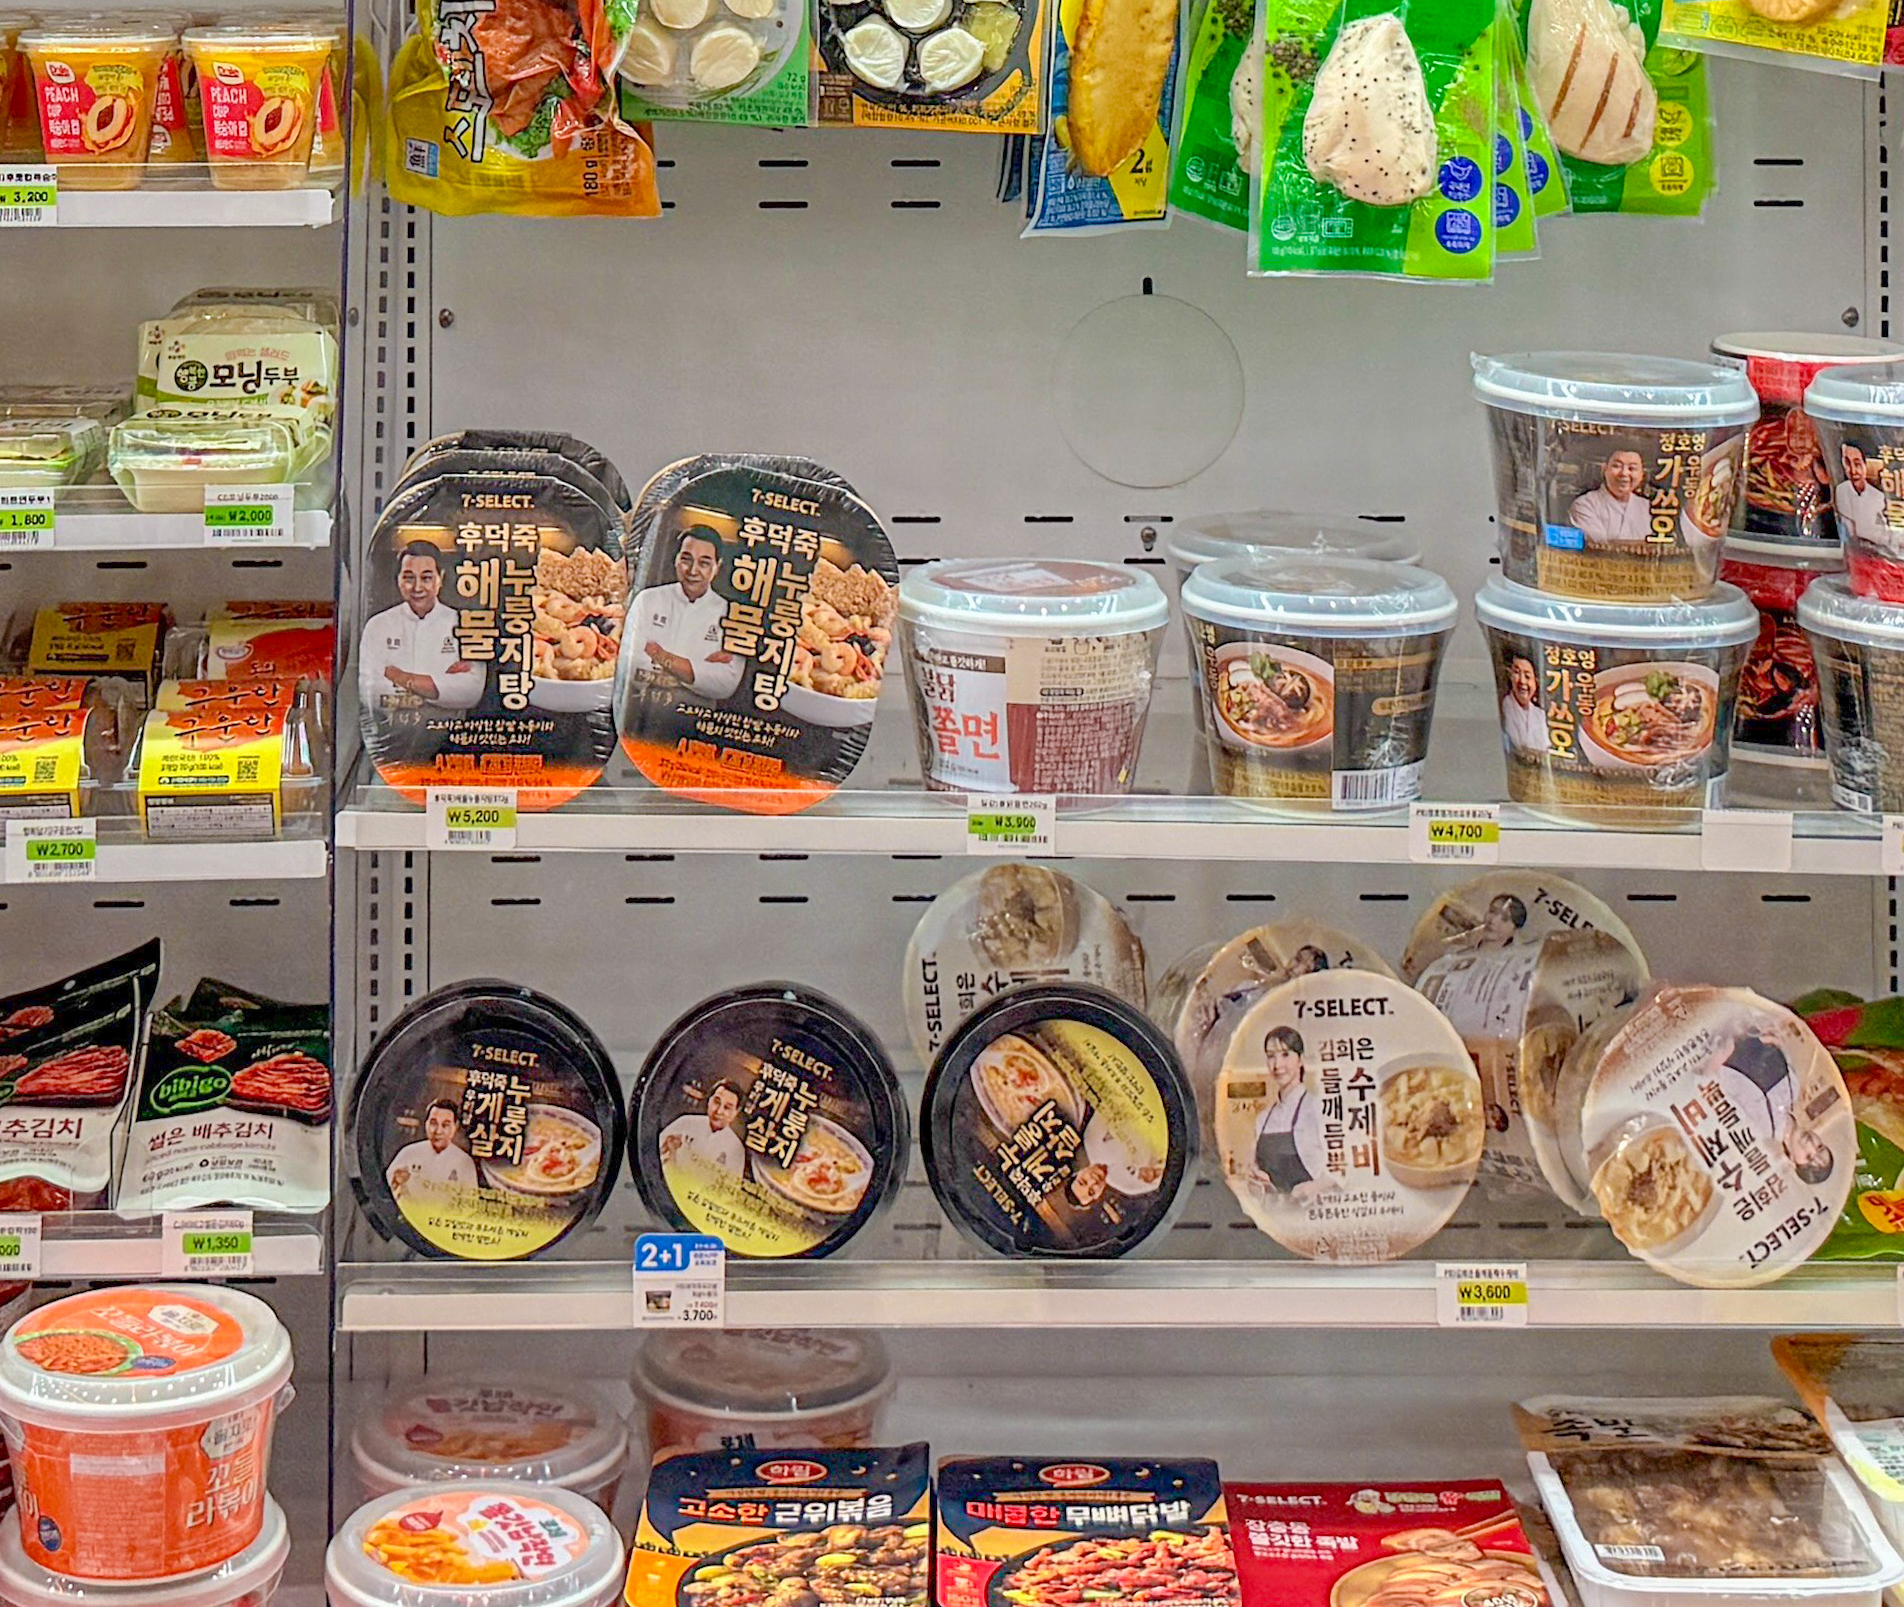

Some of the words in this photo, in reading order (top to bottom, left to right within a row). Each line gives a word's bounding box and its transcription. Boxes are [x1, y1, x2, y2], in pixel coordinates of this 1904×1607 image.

[461, 494, 536, 510] 7-SELECT
[751, 490, 822, 517] 7-SELECT
[455, 522, 538, 553] 후덕죽
[738, 516, 821, 562] 후덕죽
[930, 709, 1001, 761] 쫄면
[448, 810, 500, 825] ₩5,200
[1292, 996, 1395, 1020] 7-SELECT
[1318, 1038, 1375, 1062] 김희은
[158, 1072, 229, 1101] bibigo
[642, 1245, 684, 1269] 2+1
[677, 1498, 769, 1525] 고소한
